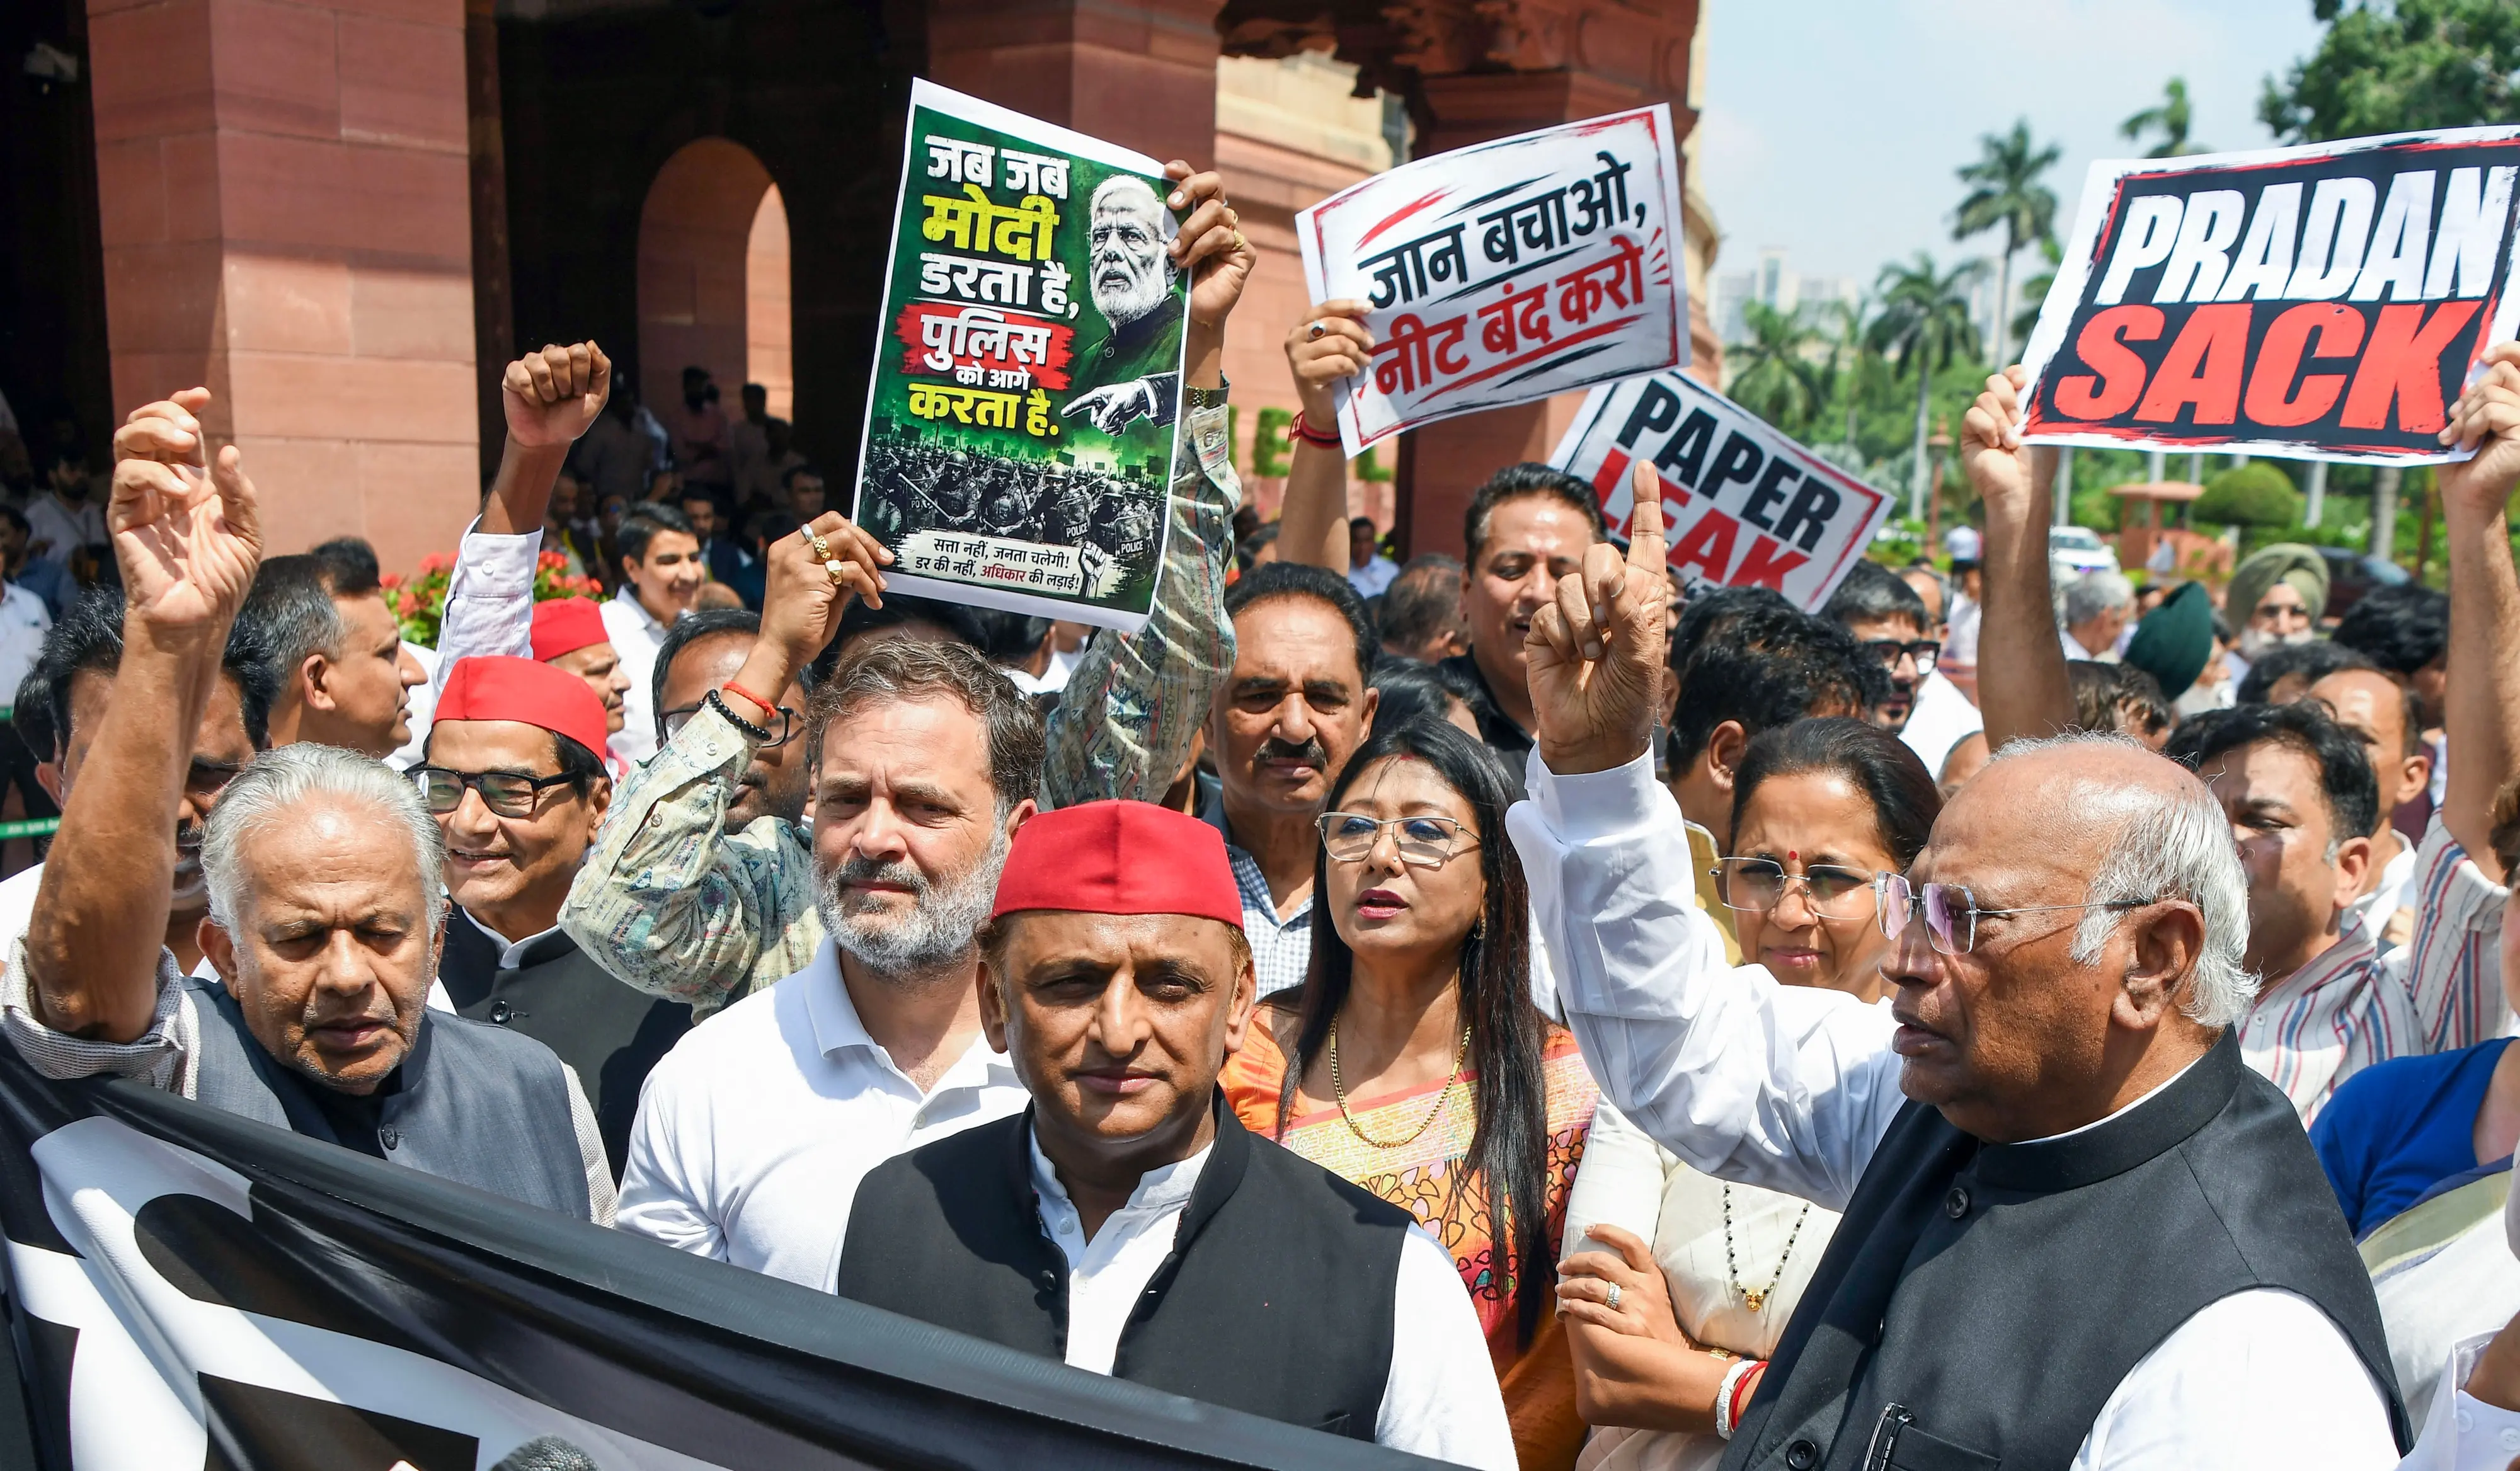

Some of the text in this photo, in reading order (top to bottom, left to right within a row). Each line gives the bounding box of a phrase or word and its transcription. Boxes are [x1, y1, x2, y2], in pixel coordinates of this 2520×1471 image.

[925, 134, 1070, 200] जब जब
[922, 183, 1060, 261] मोदी
[1357, 151, 1646, 309] जान बचाओ,
[2093, 165, 2519, 305] PRADAN
[920, 253, 1080, 319] डरता है,
[1368, 234, 1646, 396] नीट बंद करो
[920, 308, 1051, 370] पुलिस
[2053, 300, 2483, 434] SACK
[956, 360, 1031, 391] को आगे
[908, 383, 1060, 437] करता है.
[1615, 379, 1842, 553] PAPER
[933, 538, 1070, 568] सत्ता नहीं, जनता चलेगी!
[1065, 522, 1089, 539] POLICE
[1120, 539, 1144, 556] POLICE
[915, 556, 1080, 591] डर की नहीं, अधिकार की लड़ाई!
